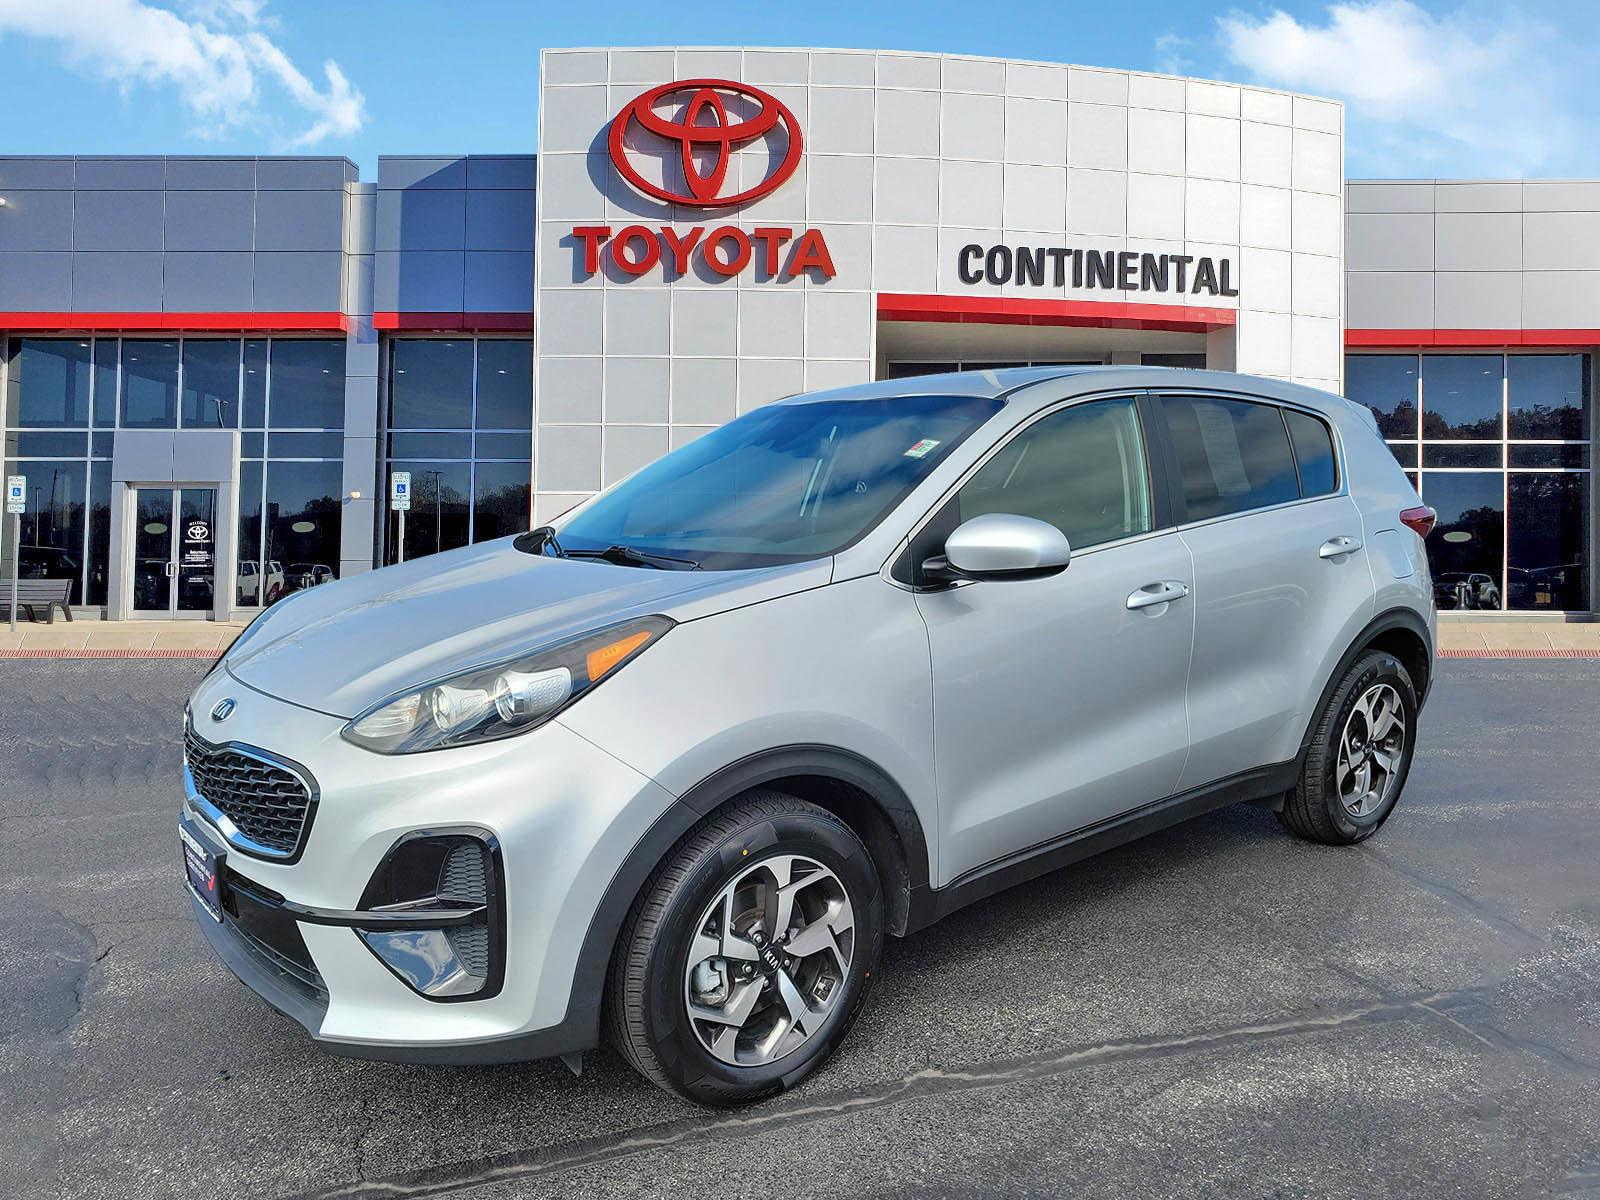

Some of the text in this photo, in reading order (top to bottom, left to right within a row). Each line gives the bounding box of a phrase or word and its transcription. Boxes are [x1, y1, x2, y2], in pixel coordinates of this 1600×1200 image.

[572, 225, 837, 277] TOYOTA
[958, 244, 1239, 297] CONTINENTAL
[764, 950, 779, 969] KIA
